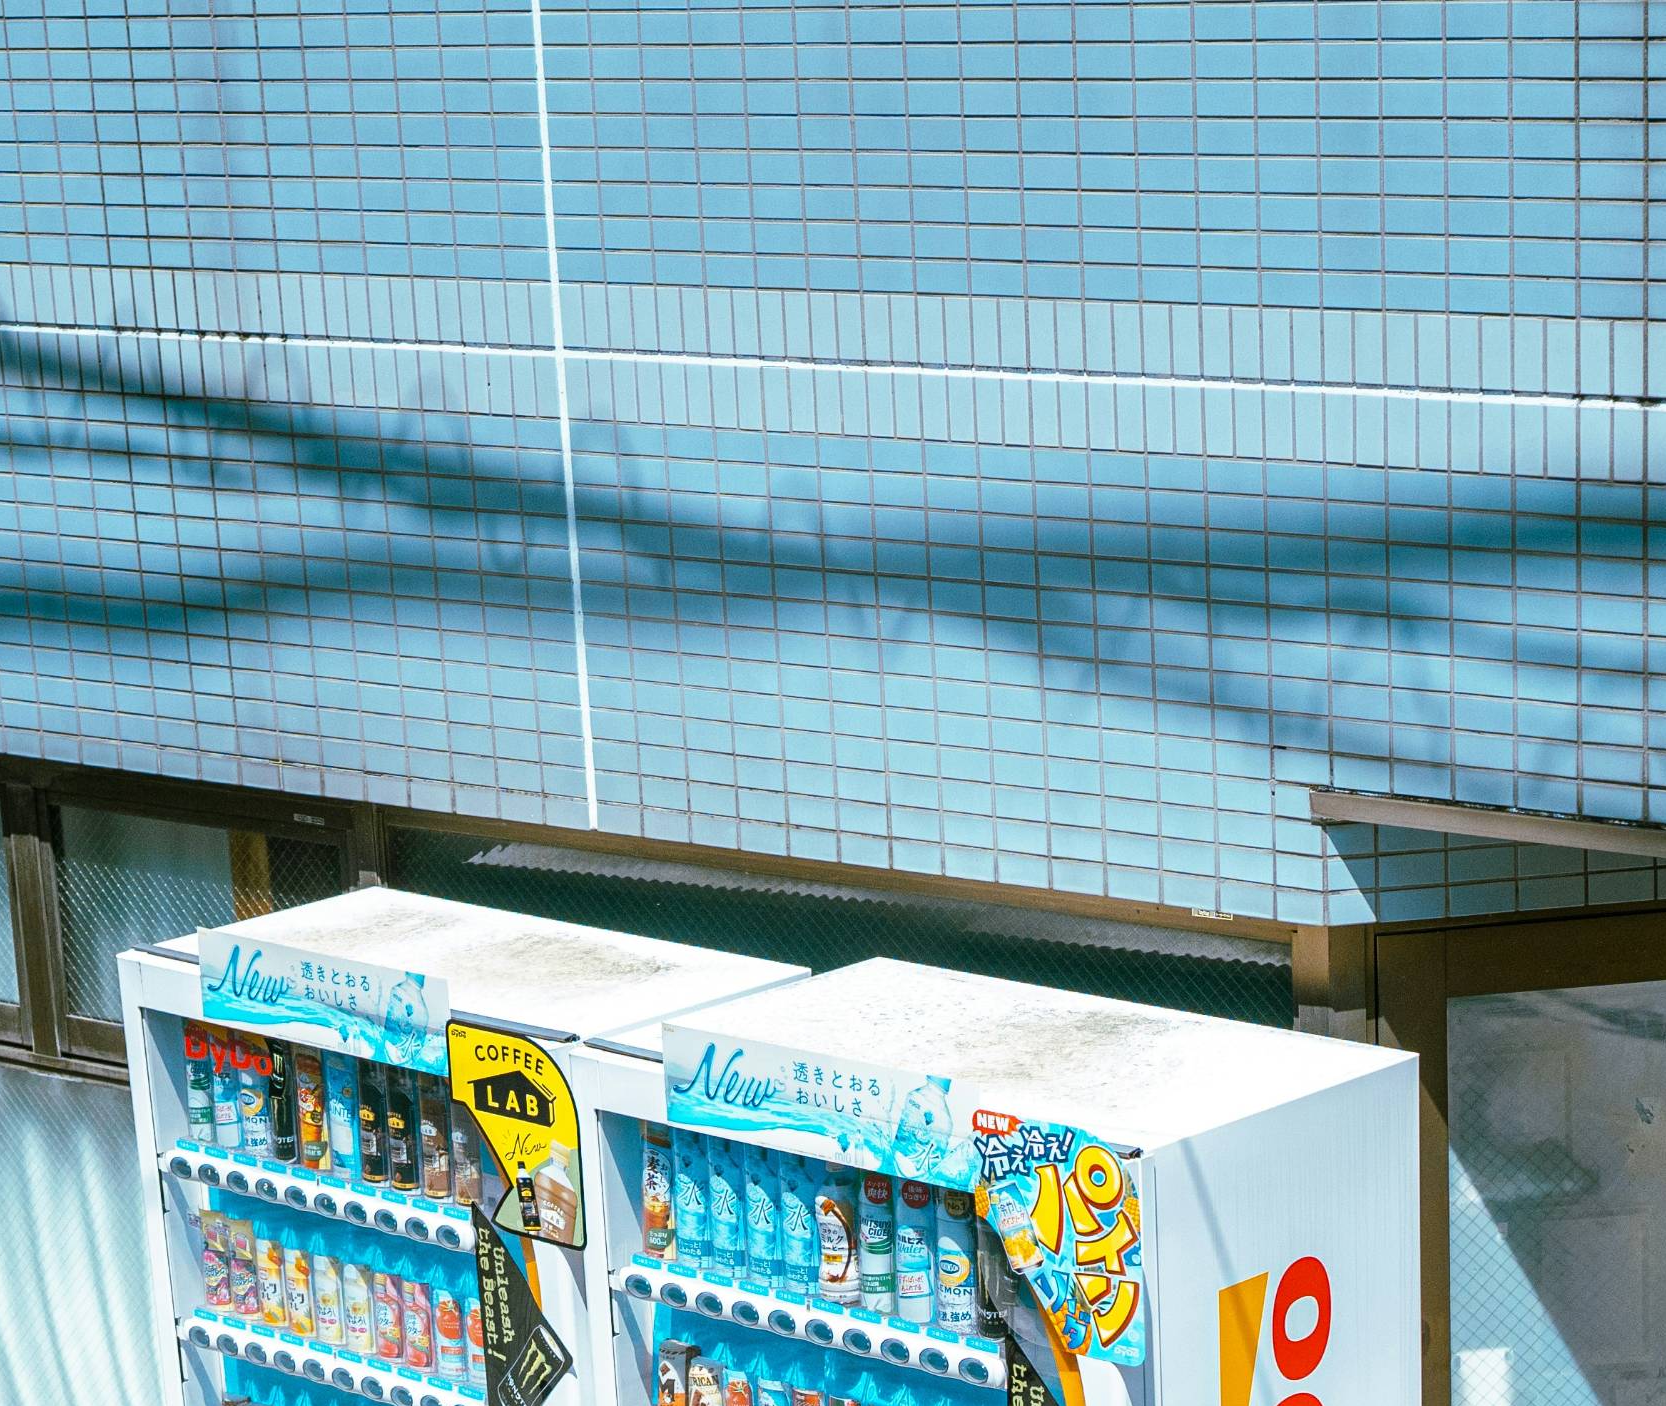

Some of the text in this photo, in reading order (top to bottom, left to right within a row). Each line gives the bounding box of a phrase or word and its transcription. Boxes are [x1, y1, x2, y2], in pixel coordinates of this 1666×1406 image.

[207, 944, 289, 1004] New
[300, 960, 371, 992] 透きとおる
[304, 985, 359, 1011] おいしさ
[184, 1031, 273, 1076] DyDo
[475, 1044, 545, 1076] COFFEE
[672, 1042, 777, 1108] New
[793, 1061, 881, 1097] 透きとおる
[486, 1085, 539, 1117] LAB
[796, 1086, 863, 1118] おいしさ
[976, 1112, 1010, 1133] NEW
[504, 1132, 547, 1160] New
[677, 1180, 704, 1206] 水
[713, 1189, 735, 1215] 水
[749, 1197, 773, 1225] 水
[785, 1204, 811, 1232] 水
[478, 1226, 491, 1273] the
[1030, 1145, 1141, 1349] パイン
[493, 1246, 516, 1344] Unleash
